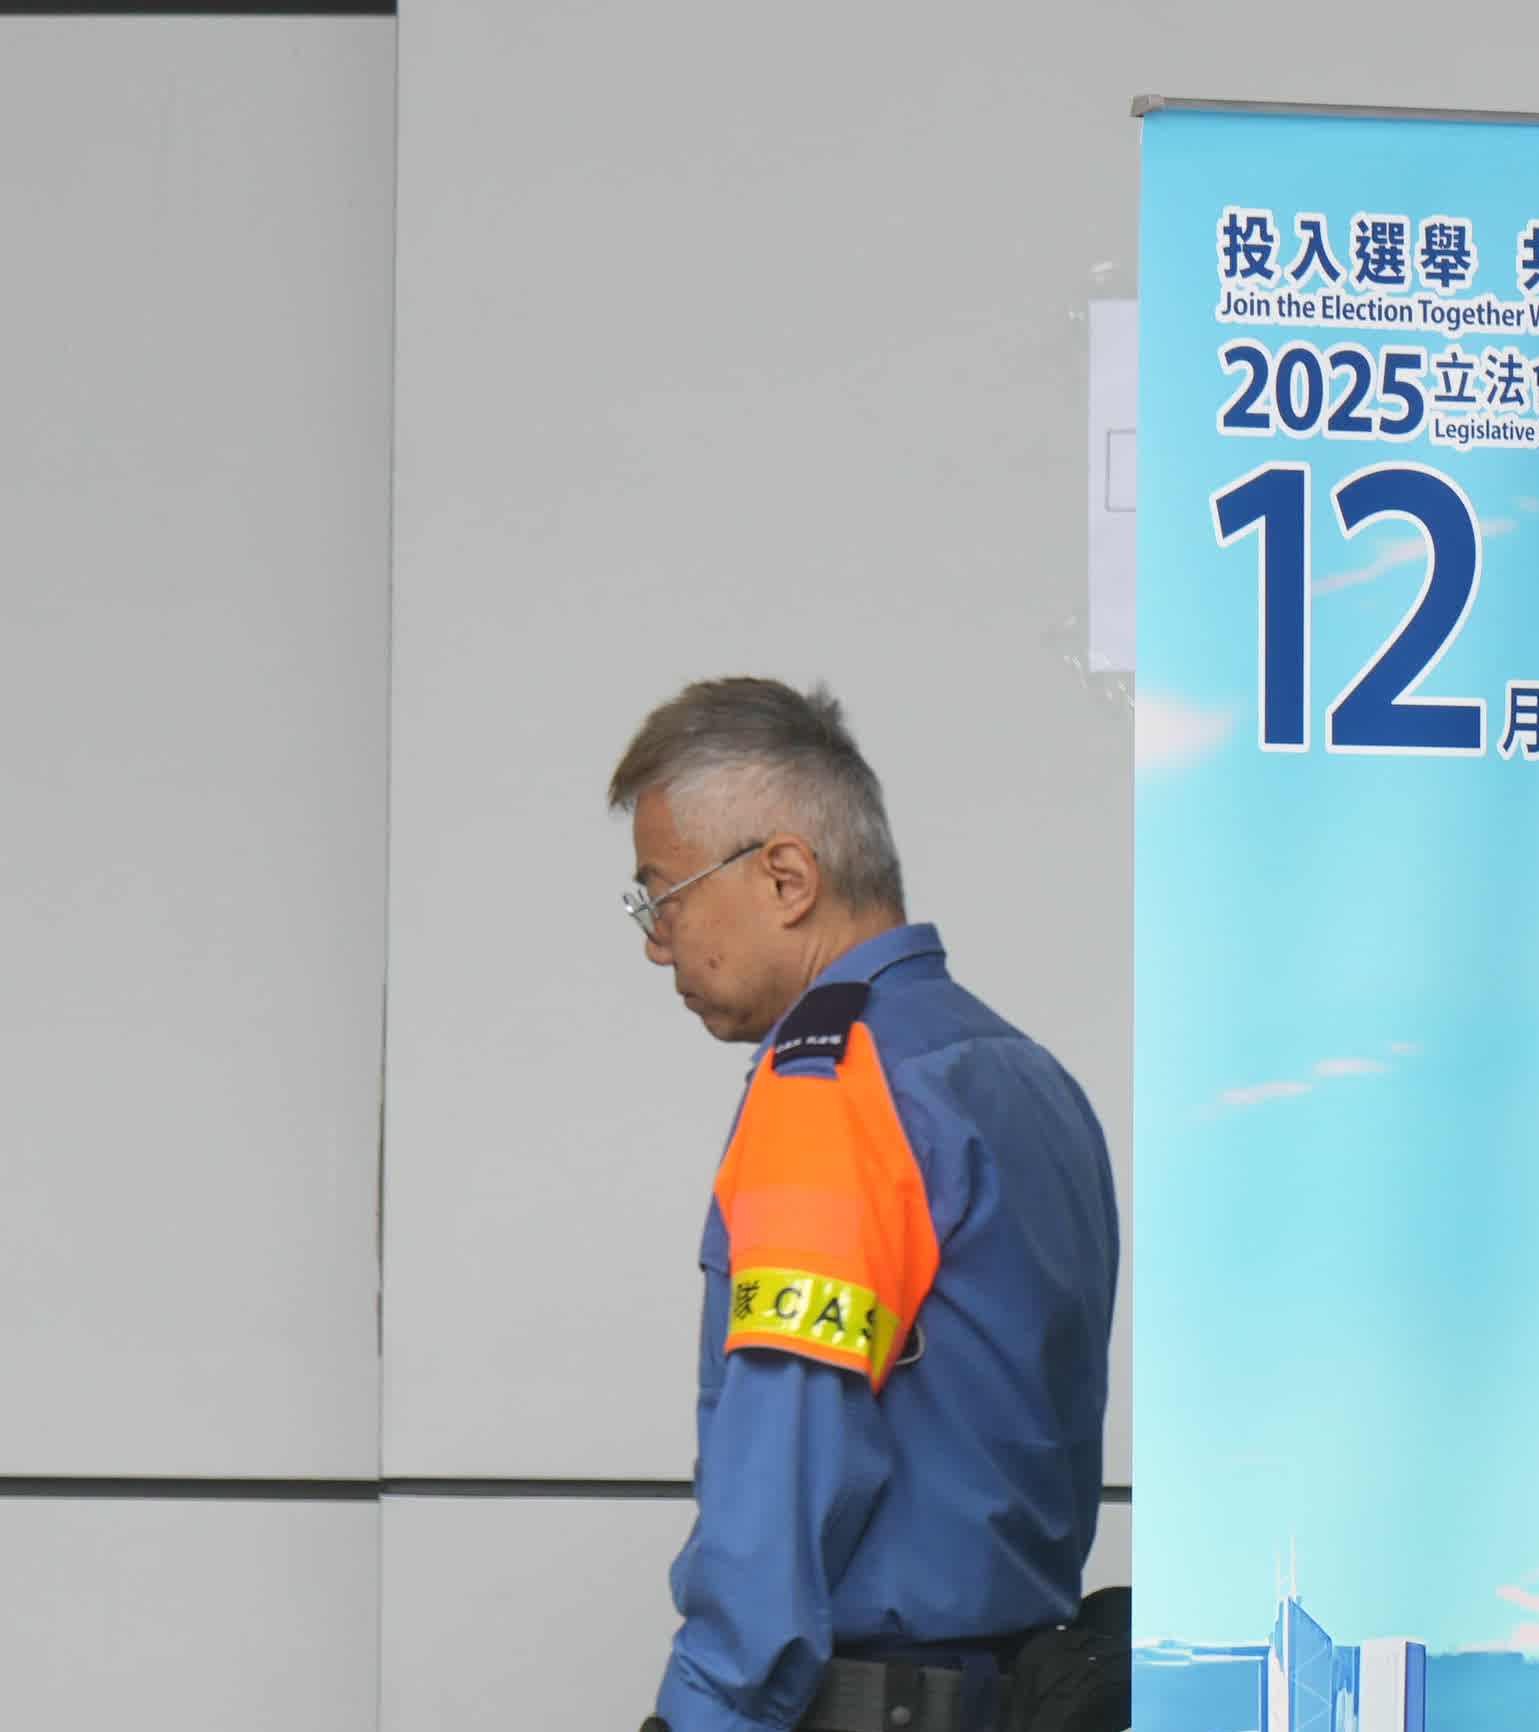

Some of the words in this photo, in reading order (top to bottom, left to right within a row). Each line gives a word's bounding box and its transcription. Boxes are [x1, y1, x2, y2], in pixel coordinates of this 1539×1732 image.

[1222, 213, 1472, 288] 投入選舉
[1221, 291, 1271, 318] Join
[1277, 292, 1316, 319] the
[1321, 295, 1413, 323] Election
[1417, 299, 1526, 331] Together
[1222, 345, 1424, 435] 2025
[1434, 418, 1536, 444] Legislative
